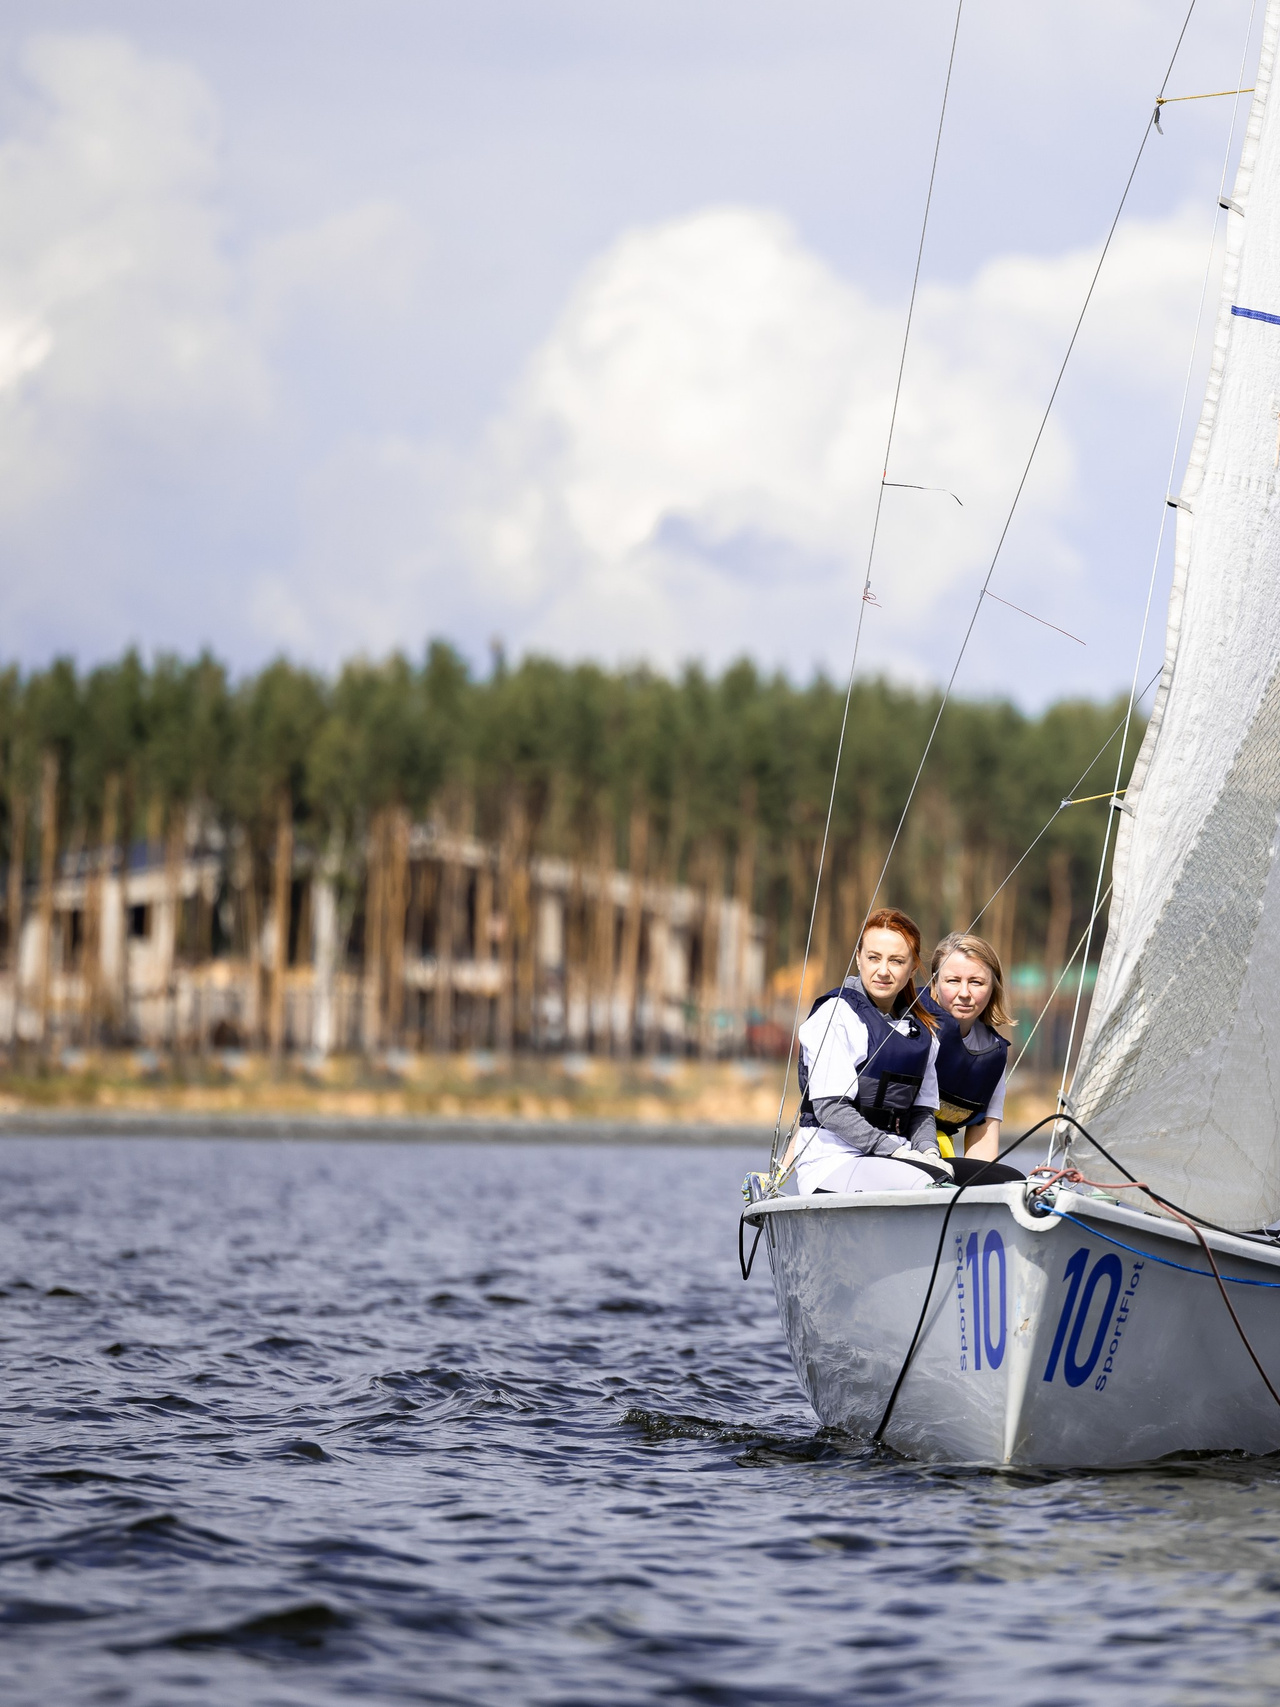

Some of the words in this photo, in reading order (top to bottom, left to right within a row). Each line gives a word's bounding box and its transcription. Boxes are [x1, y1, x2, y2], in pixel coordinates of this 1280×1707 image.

[965, 1229, 1007, 1371] 10
[1042, 1247, 1123, 1388] 10
[1094, 1260, 1145, 1392] SportFlot
